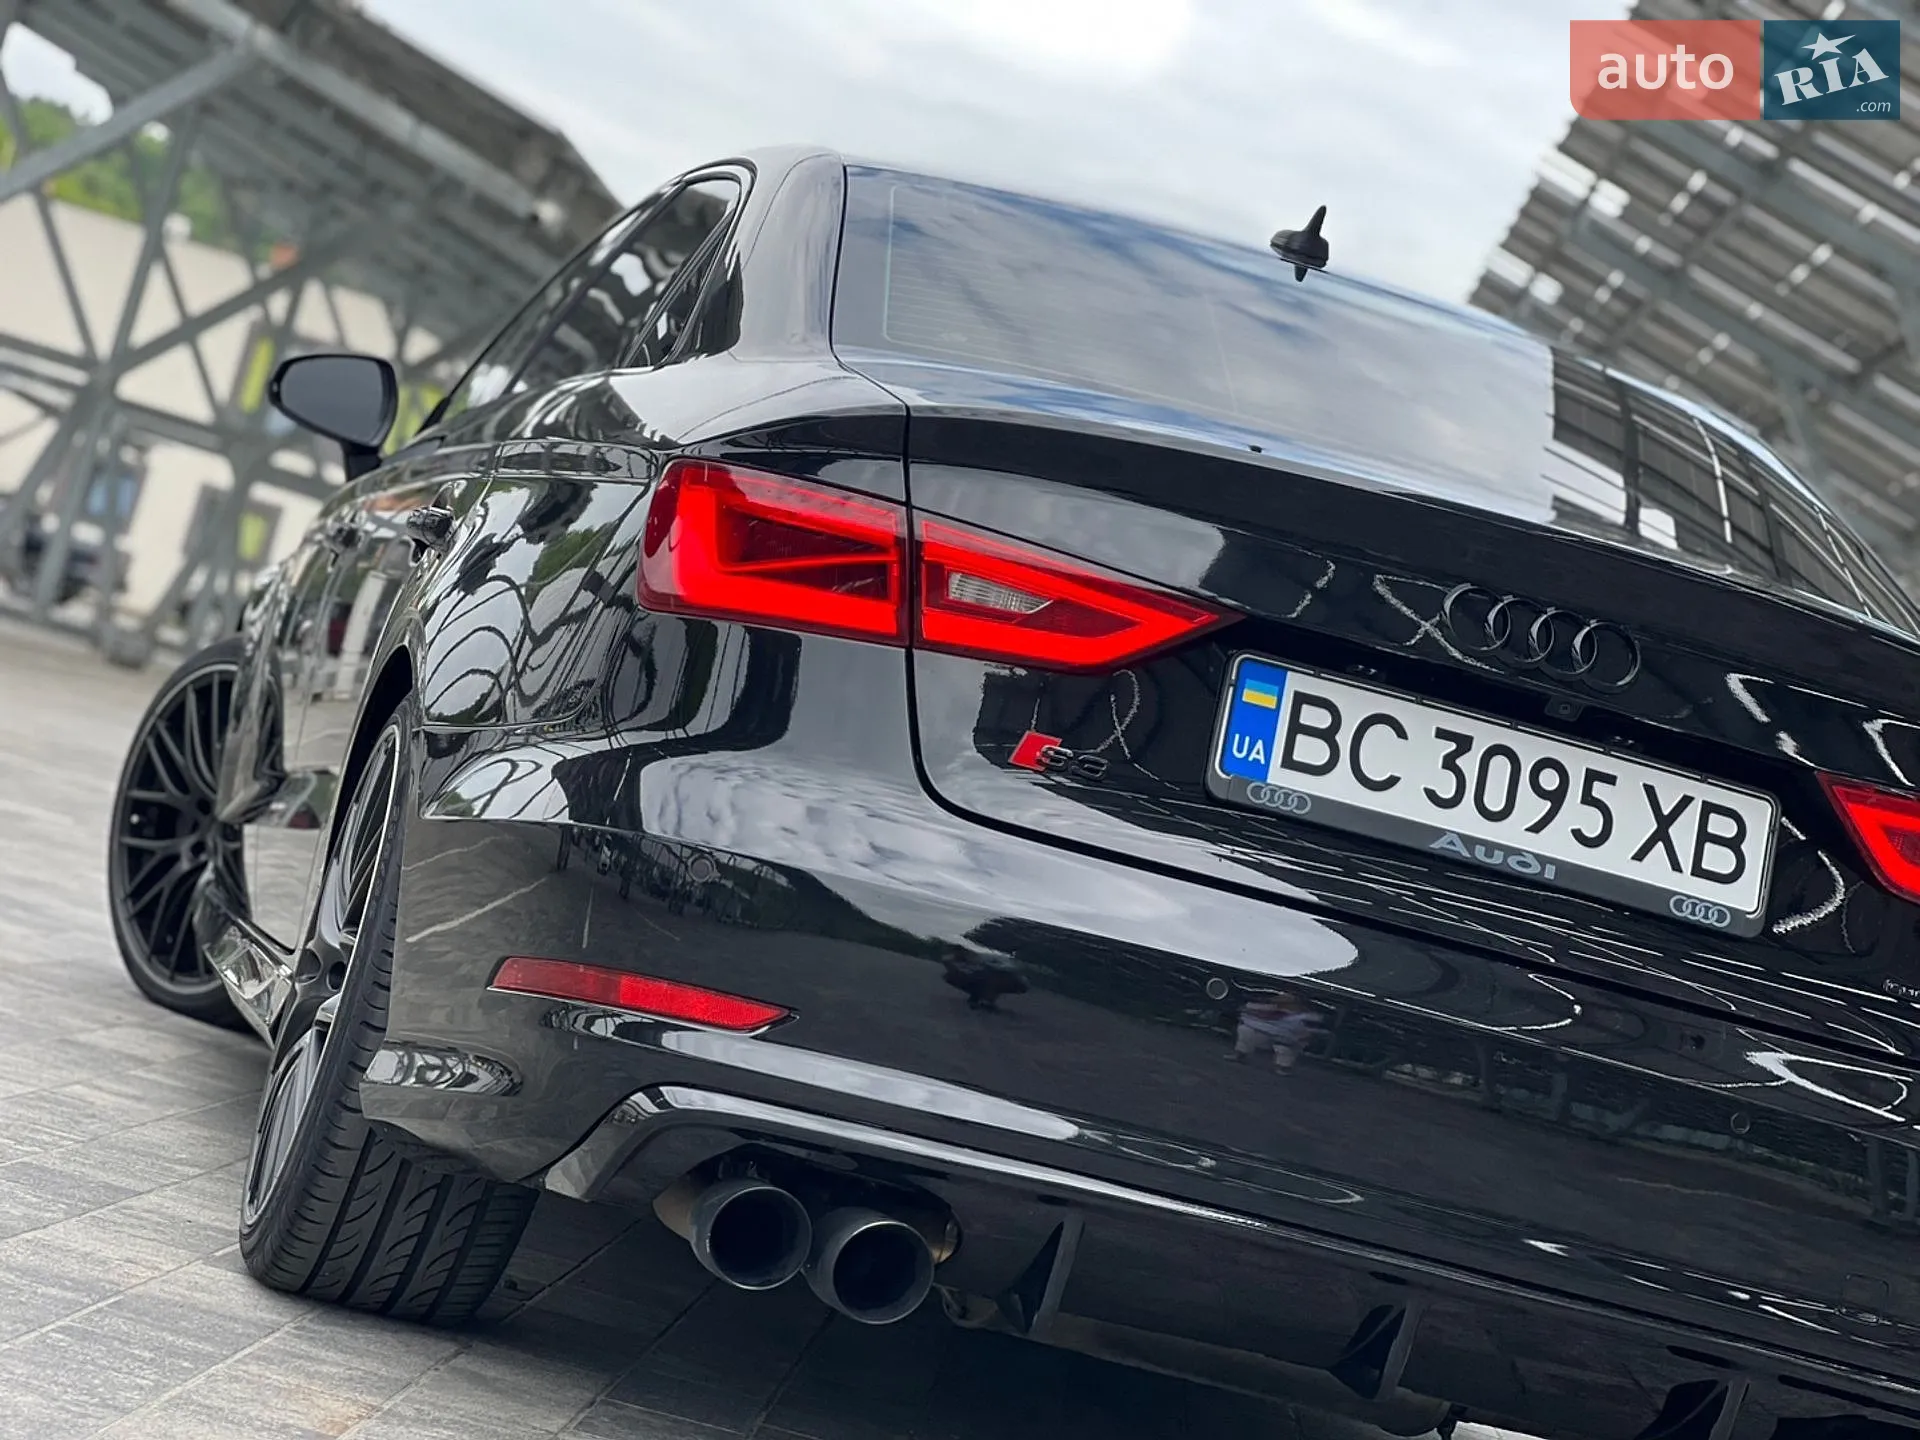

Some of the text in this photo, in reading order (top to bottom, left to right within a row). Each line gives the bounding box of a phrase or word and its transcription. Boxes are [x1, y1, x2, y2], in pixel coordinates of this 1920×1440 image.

[1231, 734, 1266, 766] UA
[1281, 690, 1748, 884] BC 3095 XB
